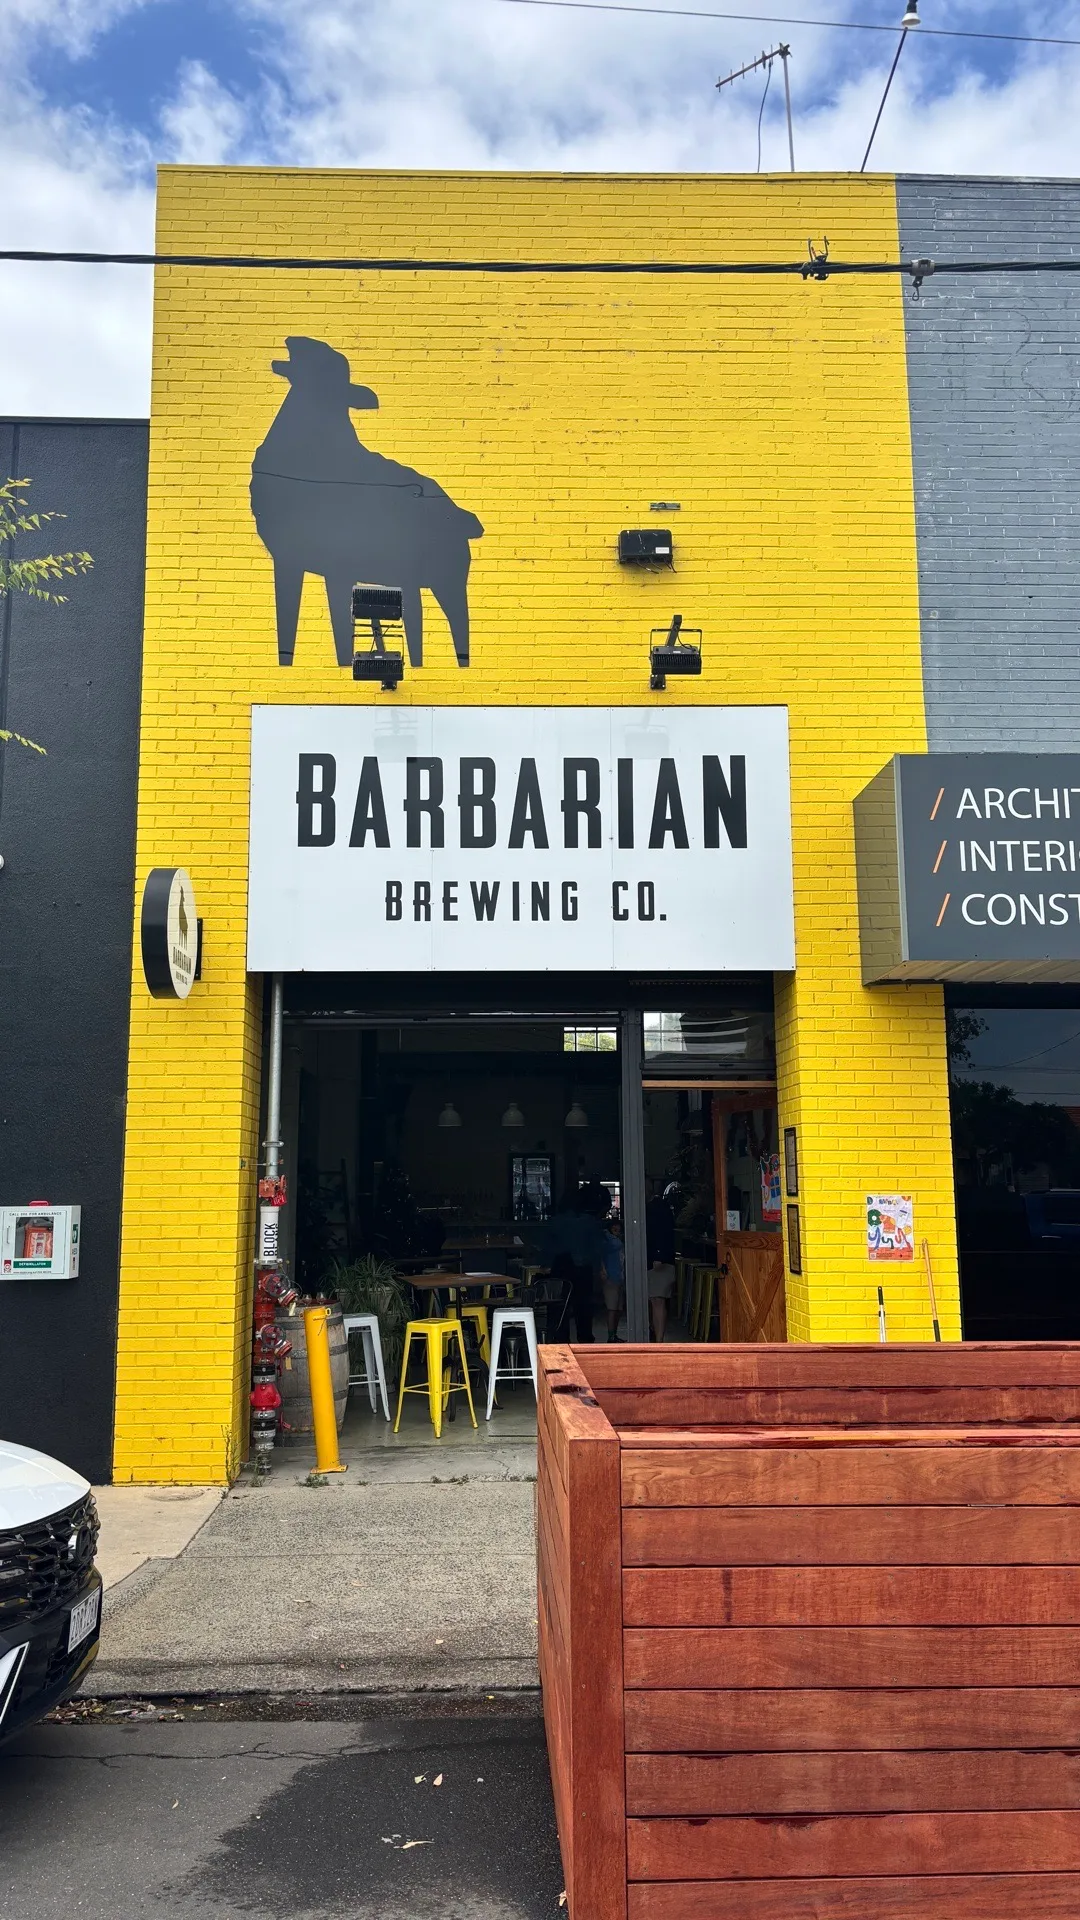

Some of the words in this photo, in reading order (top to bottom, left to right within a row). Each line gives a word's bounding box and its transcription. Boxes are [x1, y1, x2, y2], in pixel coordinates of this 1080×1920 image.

[296, 753, 748, 849] BARBARIAN
[959, 840, 1080, 872] INTERI
[385, 880, 578, 922] BREWING
[612, 880, 667, 922] CO.
[263, 1223, 276, 1257] BLOCK
